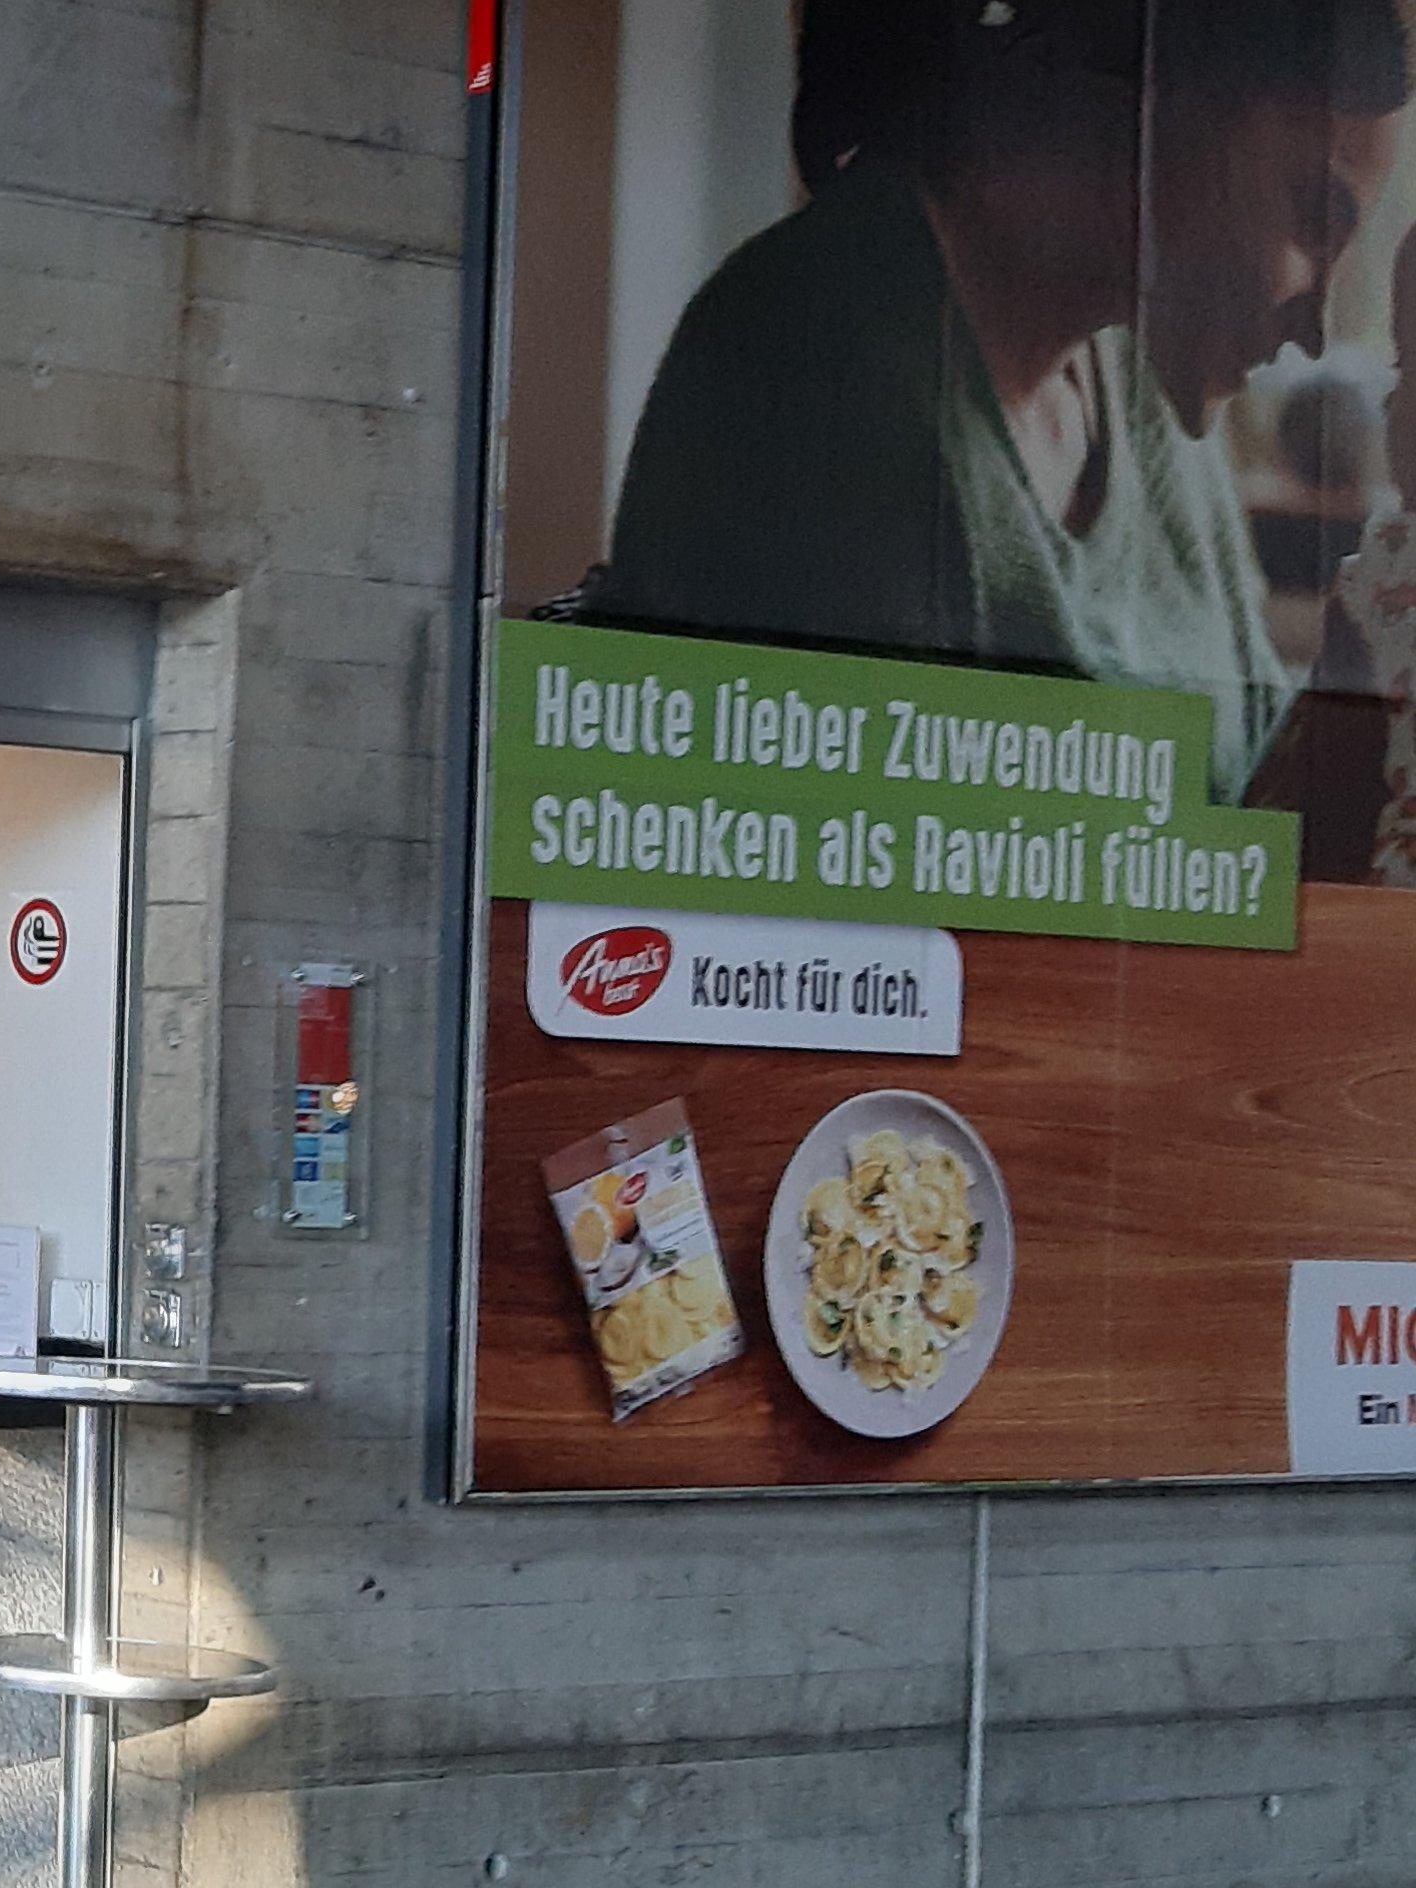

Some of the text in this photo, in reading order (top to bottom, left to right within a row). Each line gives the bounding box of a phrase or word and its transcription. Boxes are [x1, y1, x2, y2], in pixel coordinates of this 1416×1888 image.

[534, 664, 1176, 826] Heute lieber Zuwendung
[530, 788, 1268, 917] schenken als Ravioli füllen?
[691, 956, 929, 1020] Kocht für dich.
[1358, 1394, 1401, 1426] En
